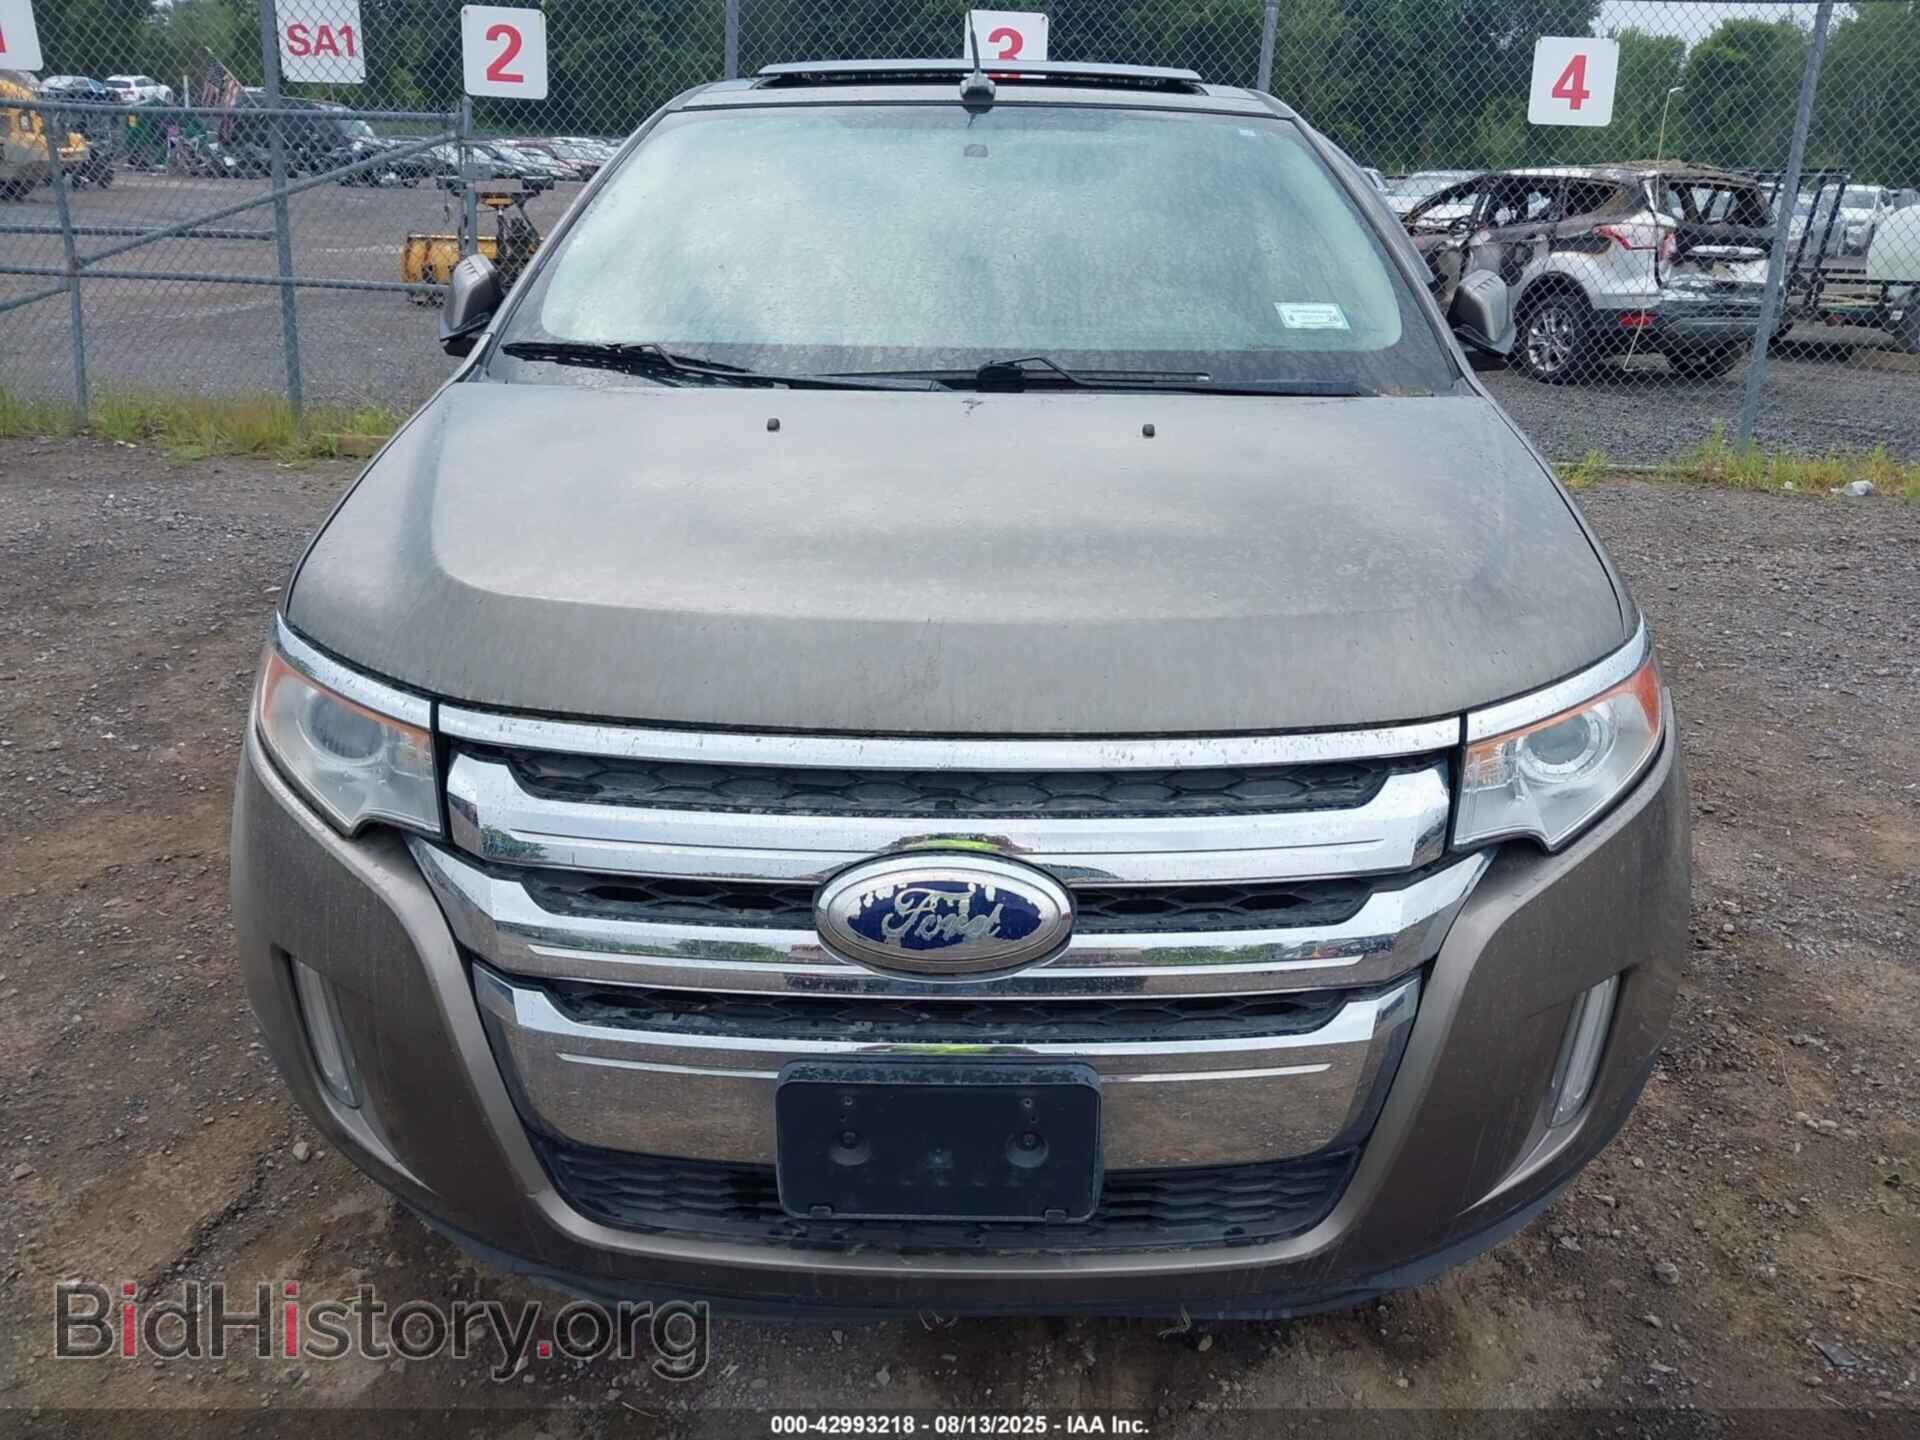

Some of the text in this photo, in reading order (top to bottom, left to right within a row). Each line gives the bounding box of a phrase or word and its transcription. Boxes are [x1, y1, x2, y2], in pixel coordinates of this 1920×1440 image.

[286, 24, 355, 57] SA1
[485, 24, 524, 84] 2
[1551, 54, 1590, 110] 4
[881, 887, 1004, 942] Ford
